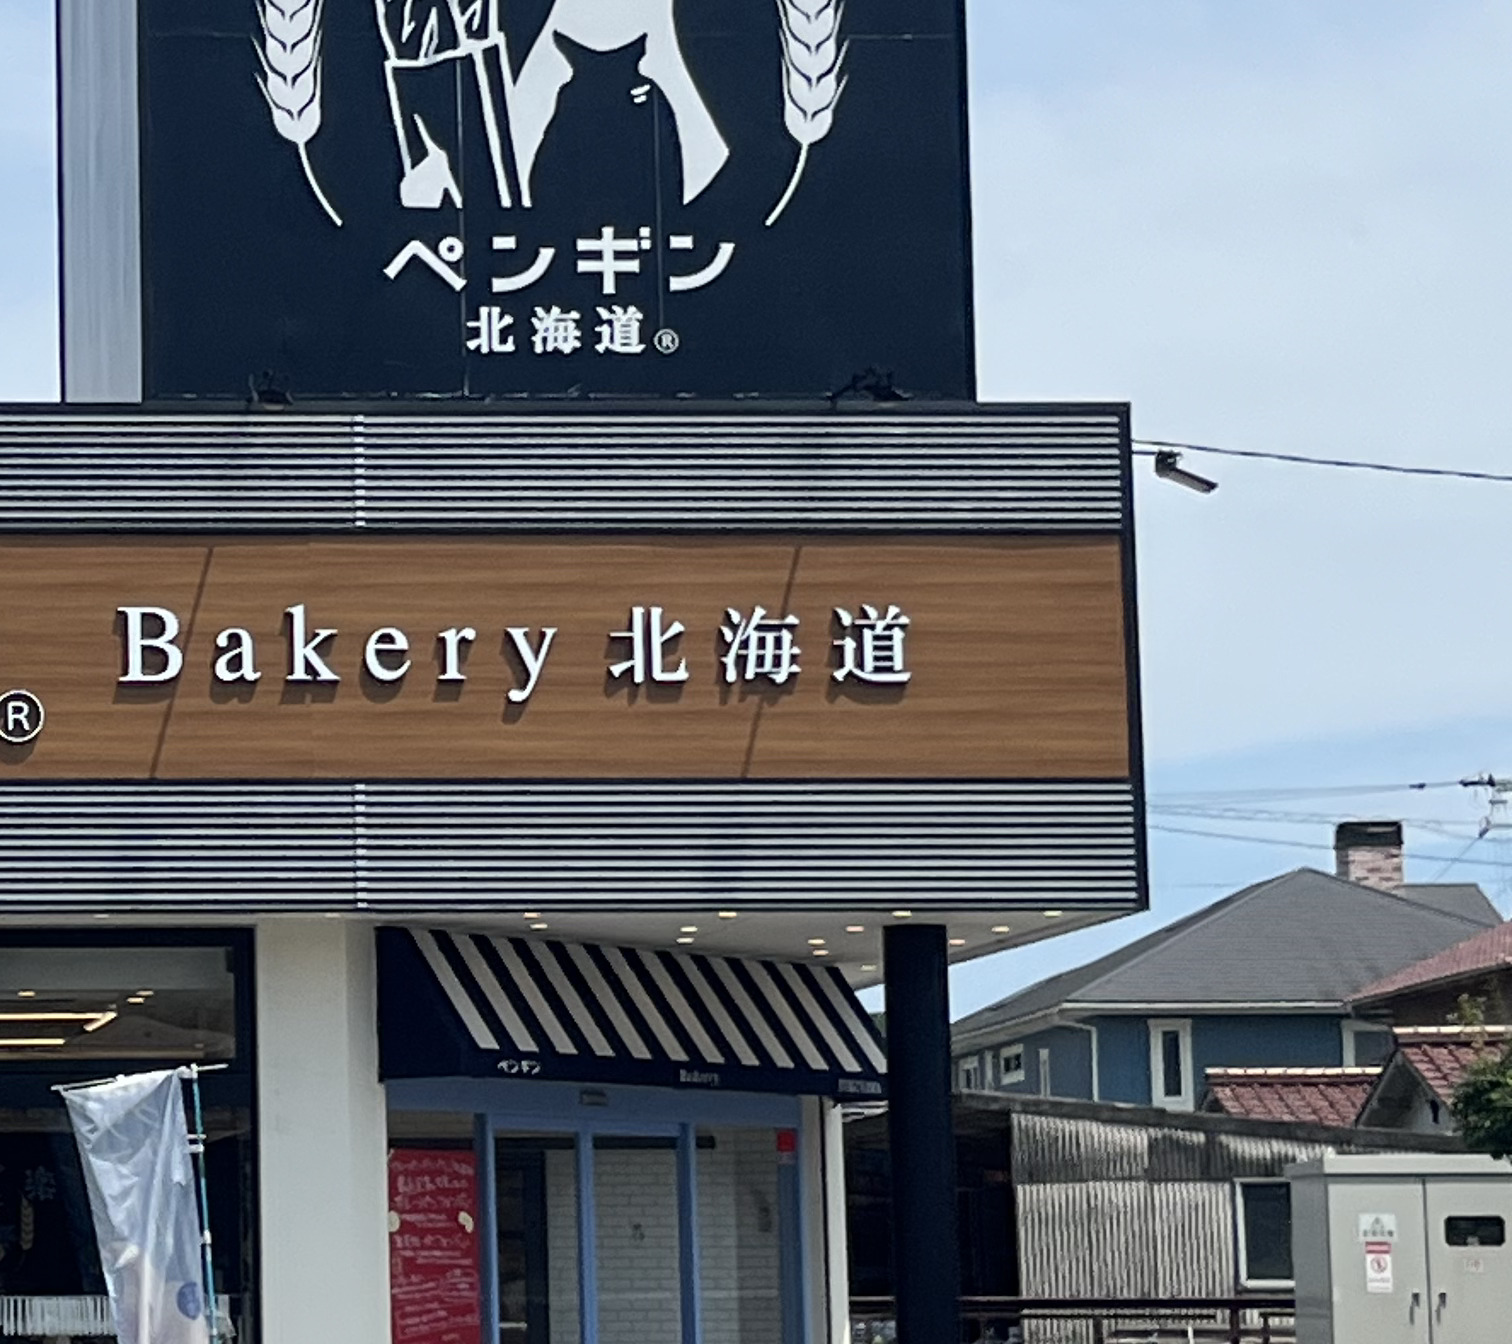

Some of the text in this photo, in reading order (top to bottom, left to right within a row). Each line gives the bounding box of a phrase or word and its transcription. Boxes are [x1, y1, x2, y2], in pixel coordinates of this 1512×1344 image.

[383, 226, 736, 294] ペンギン
[466, 305, 646, 354] 北海道
[116, 604, 558, 703] Bakery
[608, 604, 912, 685] 北海道
